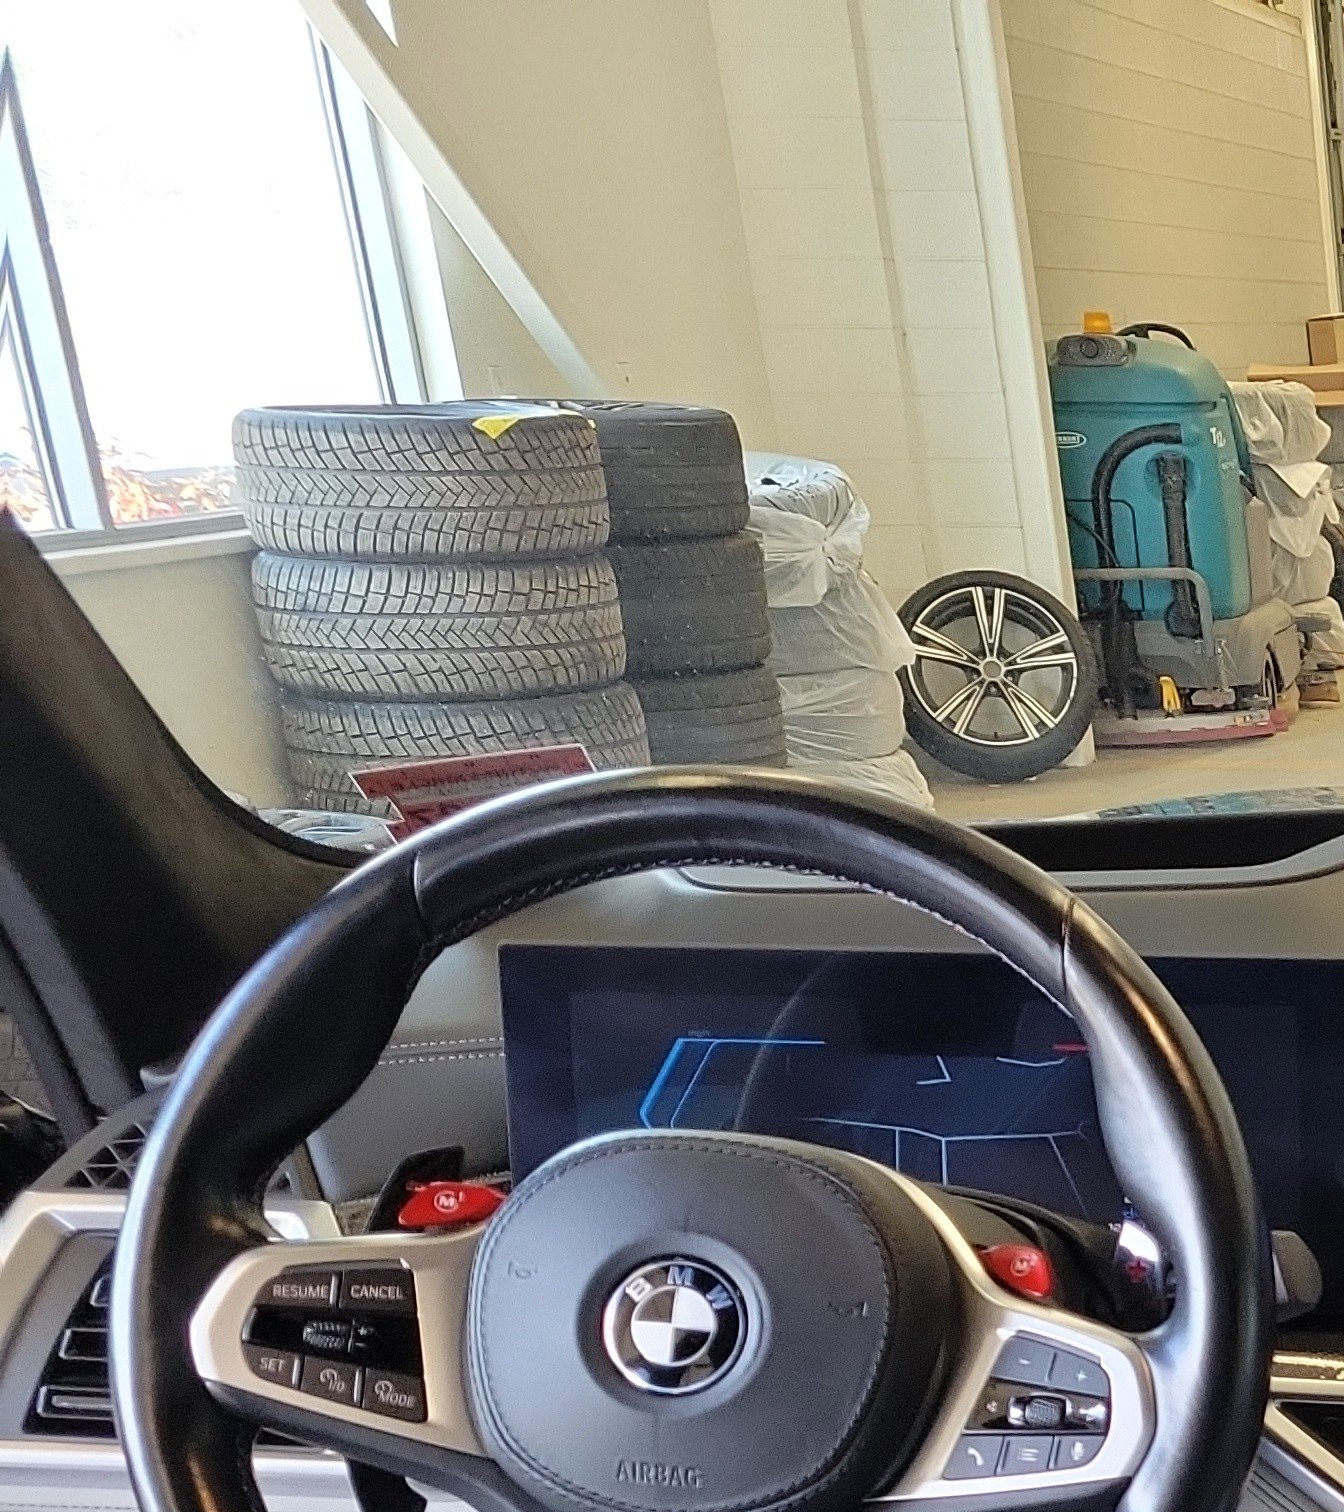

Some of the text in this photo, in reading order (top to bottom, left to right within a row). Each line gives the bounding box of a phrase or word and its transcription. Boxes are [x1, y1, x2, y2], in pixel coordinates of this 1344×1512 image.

[272, 1284, 330, 1299] RESUME
[350, 1284, 404, 1299] CANCEL
[625, 1264, 733, 1311] BMW
[260, 1358, 286, 1373] SET
[380, 1391, 415, 1408] MODE
[615, 1459, 702, 1491] AIRBAG
